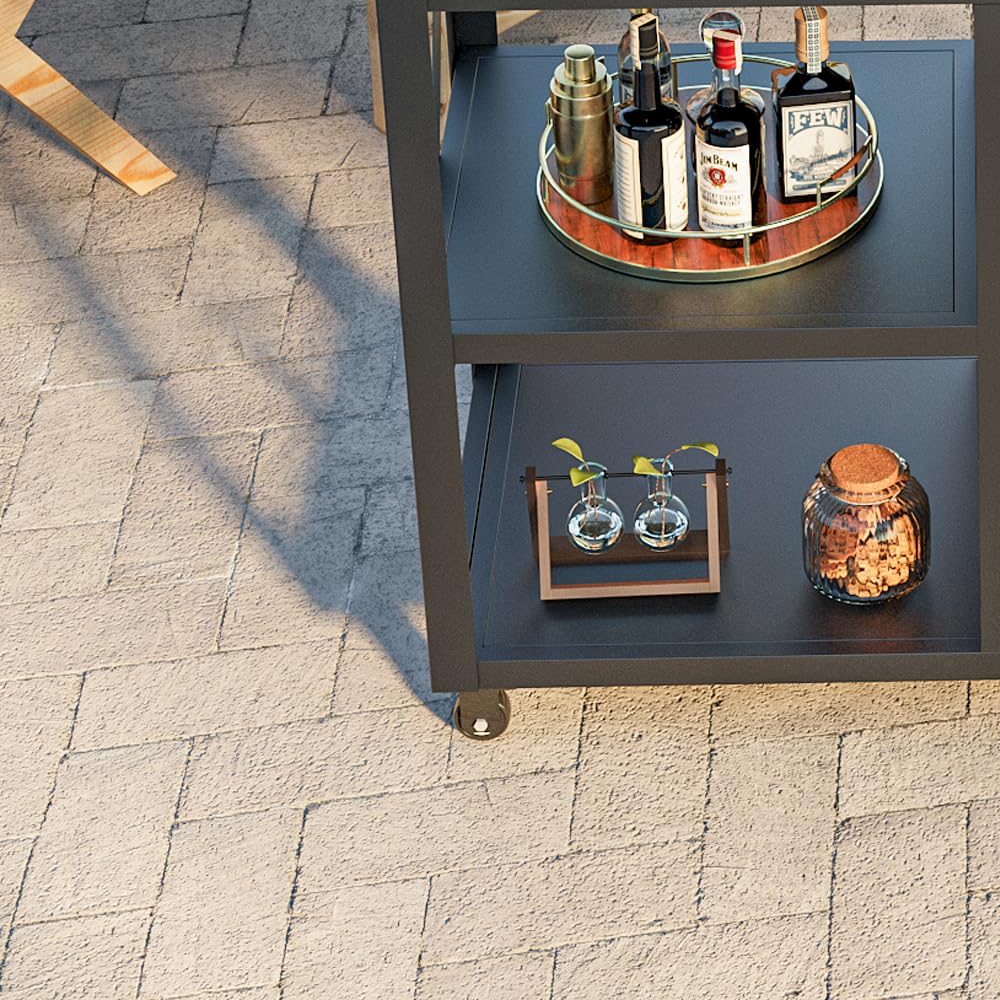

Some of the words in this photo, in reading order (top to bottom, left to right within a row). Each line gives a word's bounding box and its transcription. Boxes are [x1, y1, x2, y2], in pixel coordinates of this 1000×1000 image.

[792, 106, 843, 134] FEW
[700, 152, 712, 166] JIM
[713, 154, 738, 172] BEAM
